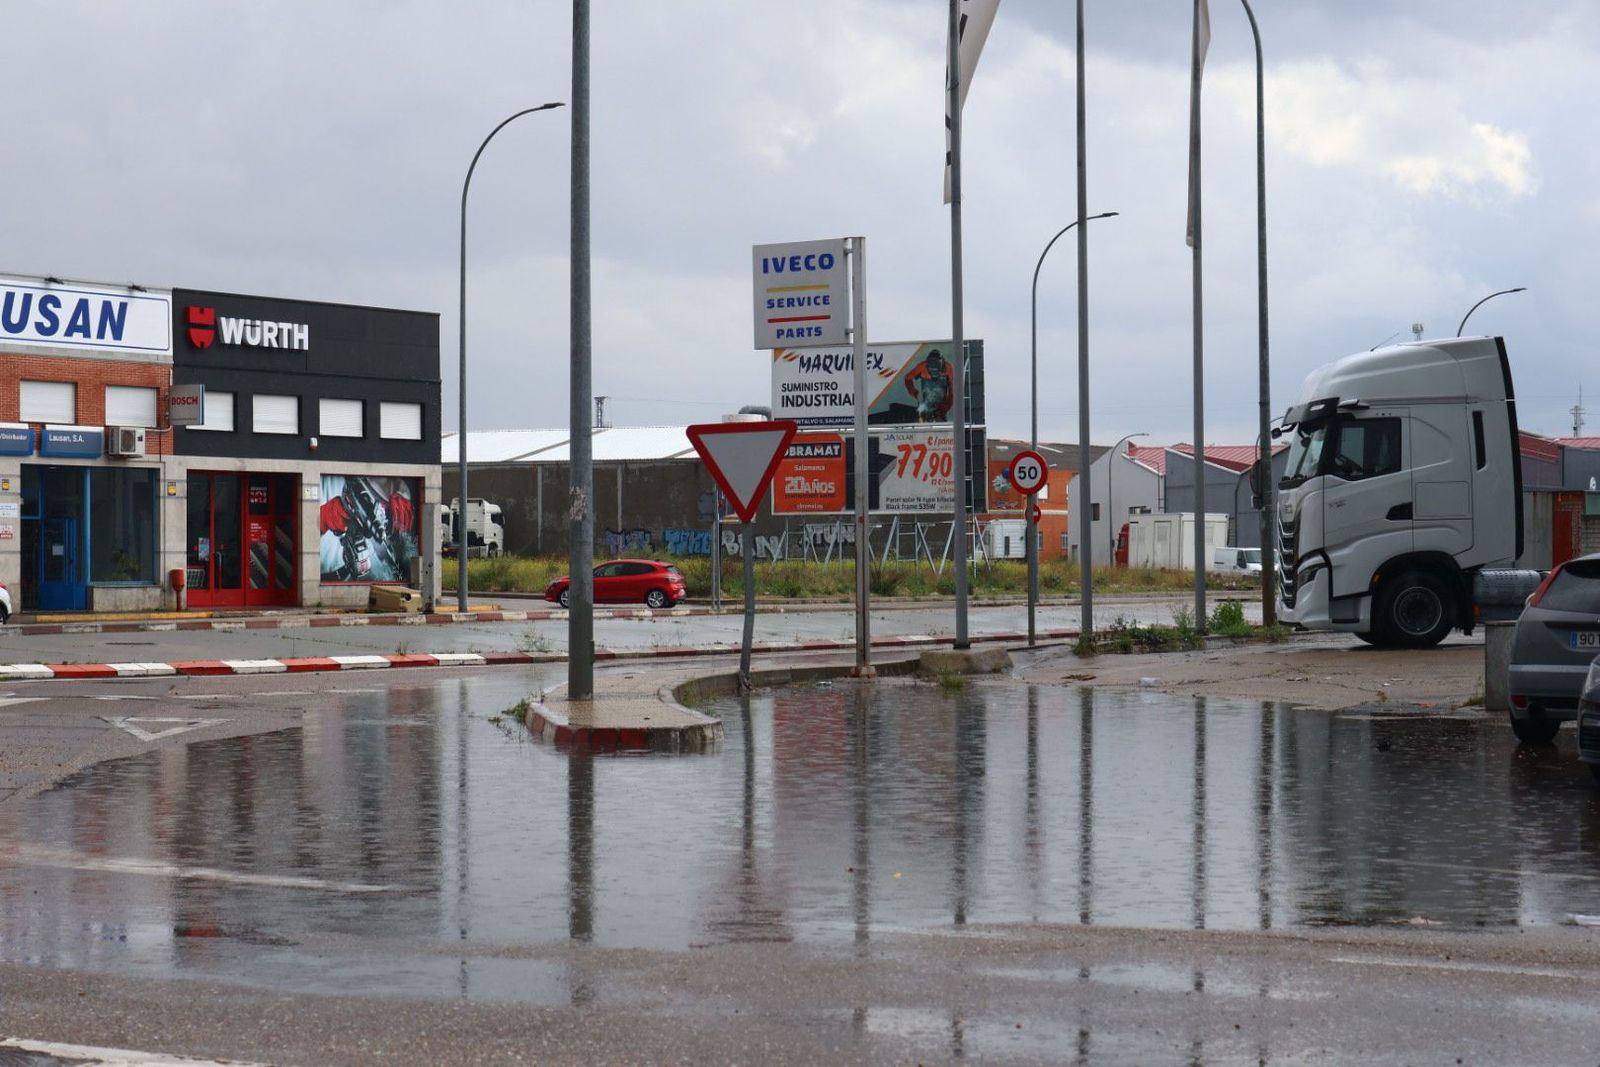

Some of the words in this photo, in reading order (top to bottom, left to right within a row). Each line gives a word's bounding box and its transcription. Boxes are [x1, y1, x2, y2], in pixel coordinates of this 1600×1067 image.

[762, 253, 834, 274] IVECO
[766, 295, 831, 309] SERVICE
[1, 291, 128, 341] USAN
[218, 316, 309, 350] WÜRTH
[776, 326, 823, 339] PARTS
[781, 381, 839, 393] SUMINISTRO
[171, 396, 198, 406] BOSCH
[897, 443, 952, 481] 77,90
[1018, 466, 1038, 480] 50
